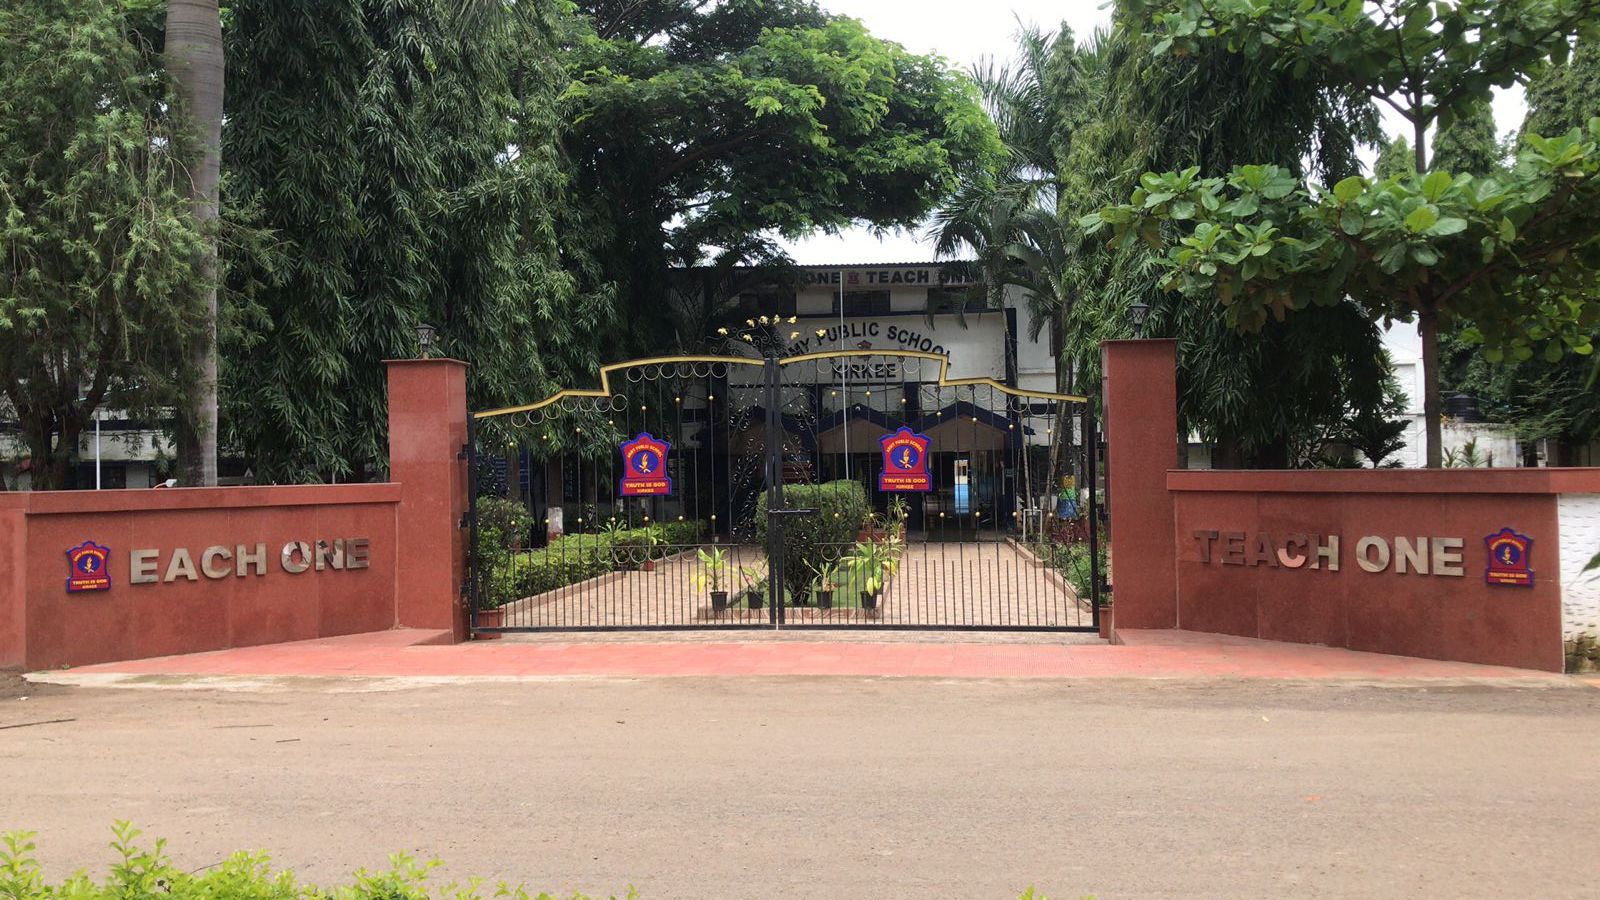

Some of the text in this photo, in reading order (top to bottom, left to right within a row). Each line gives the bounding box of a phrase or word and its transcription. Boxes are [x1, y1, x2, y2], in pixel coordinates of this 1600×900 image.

[866, 270, 930, 284] TEACH
[832, 363, 897, 379] KIRKEE
[129, 538, 370, 584] EACH ONE
[1194, 530, 1464, 577] TEACH ONE
